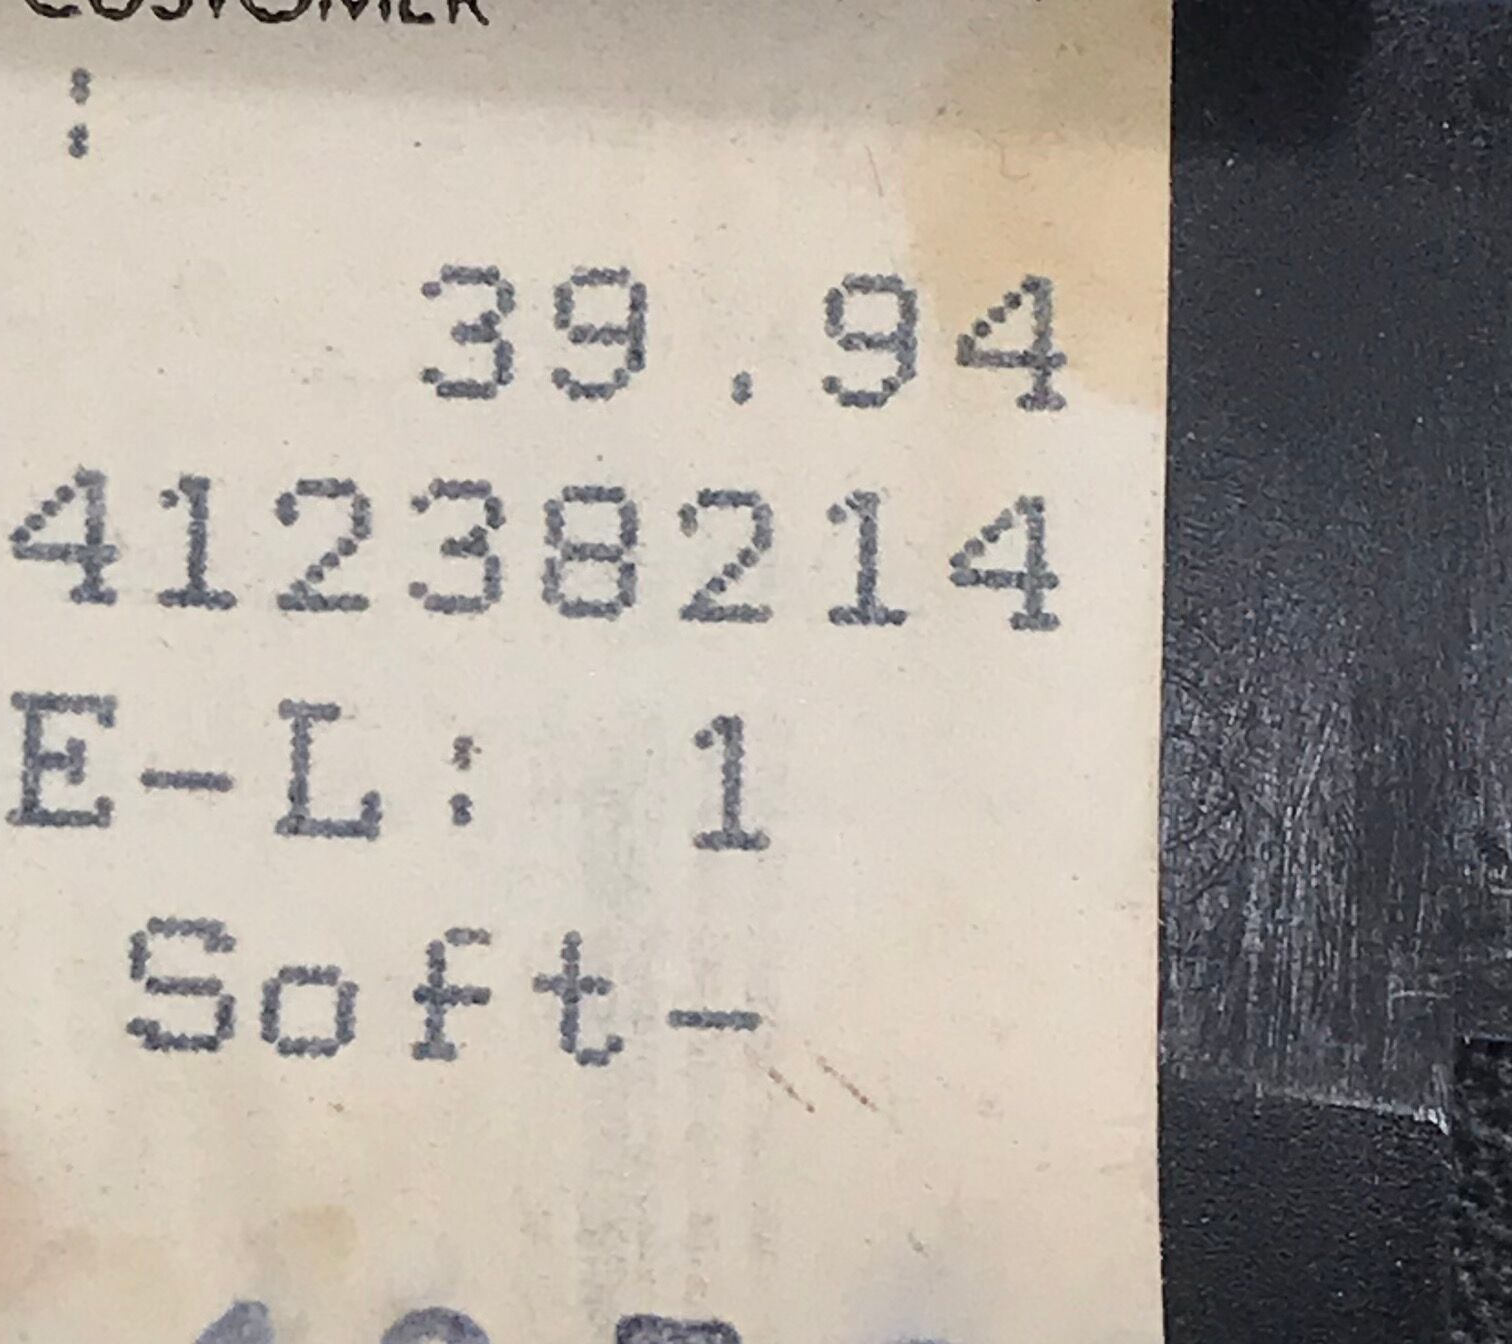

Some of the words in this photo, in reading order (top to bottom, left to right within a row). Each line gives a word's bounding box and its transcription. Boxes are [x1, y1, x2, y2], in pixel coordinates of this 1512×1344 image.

[420, 264, 1066, 413] 39.94
[9, 469, 1061, 632] 41238214
[694, 713, 772, 853] 1
[127, 916, 763, 1067] Soft-
